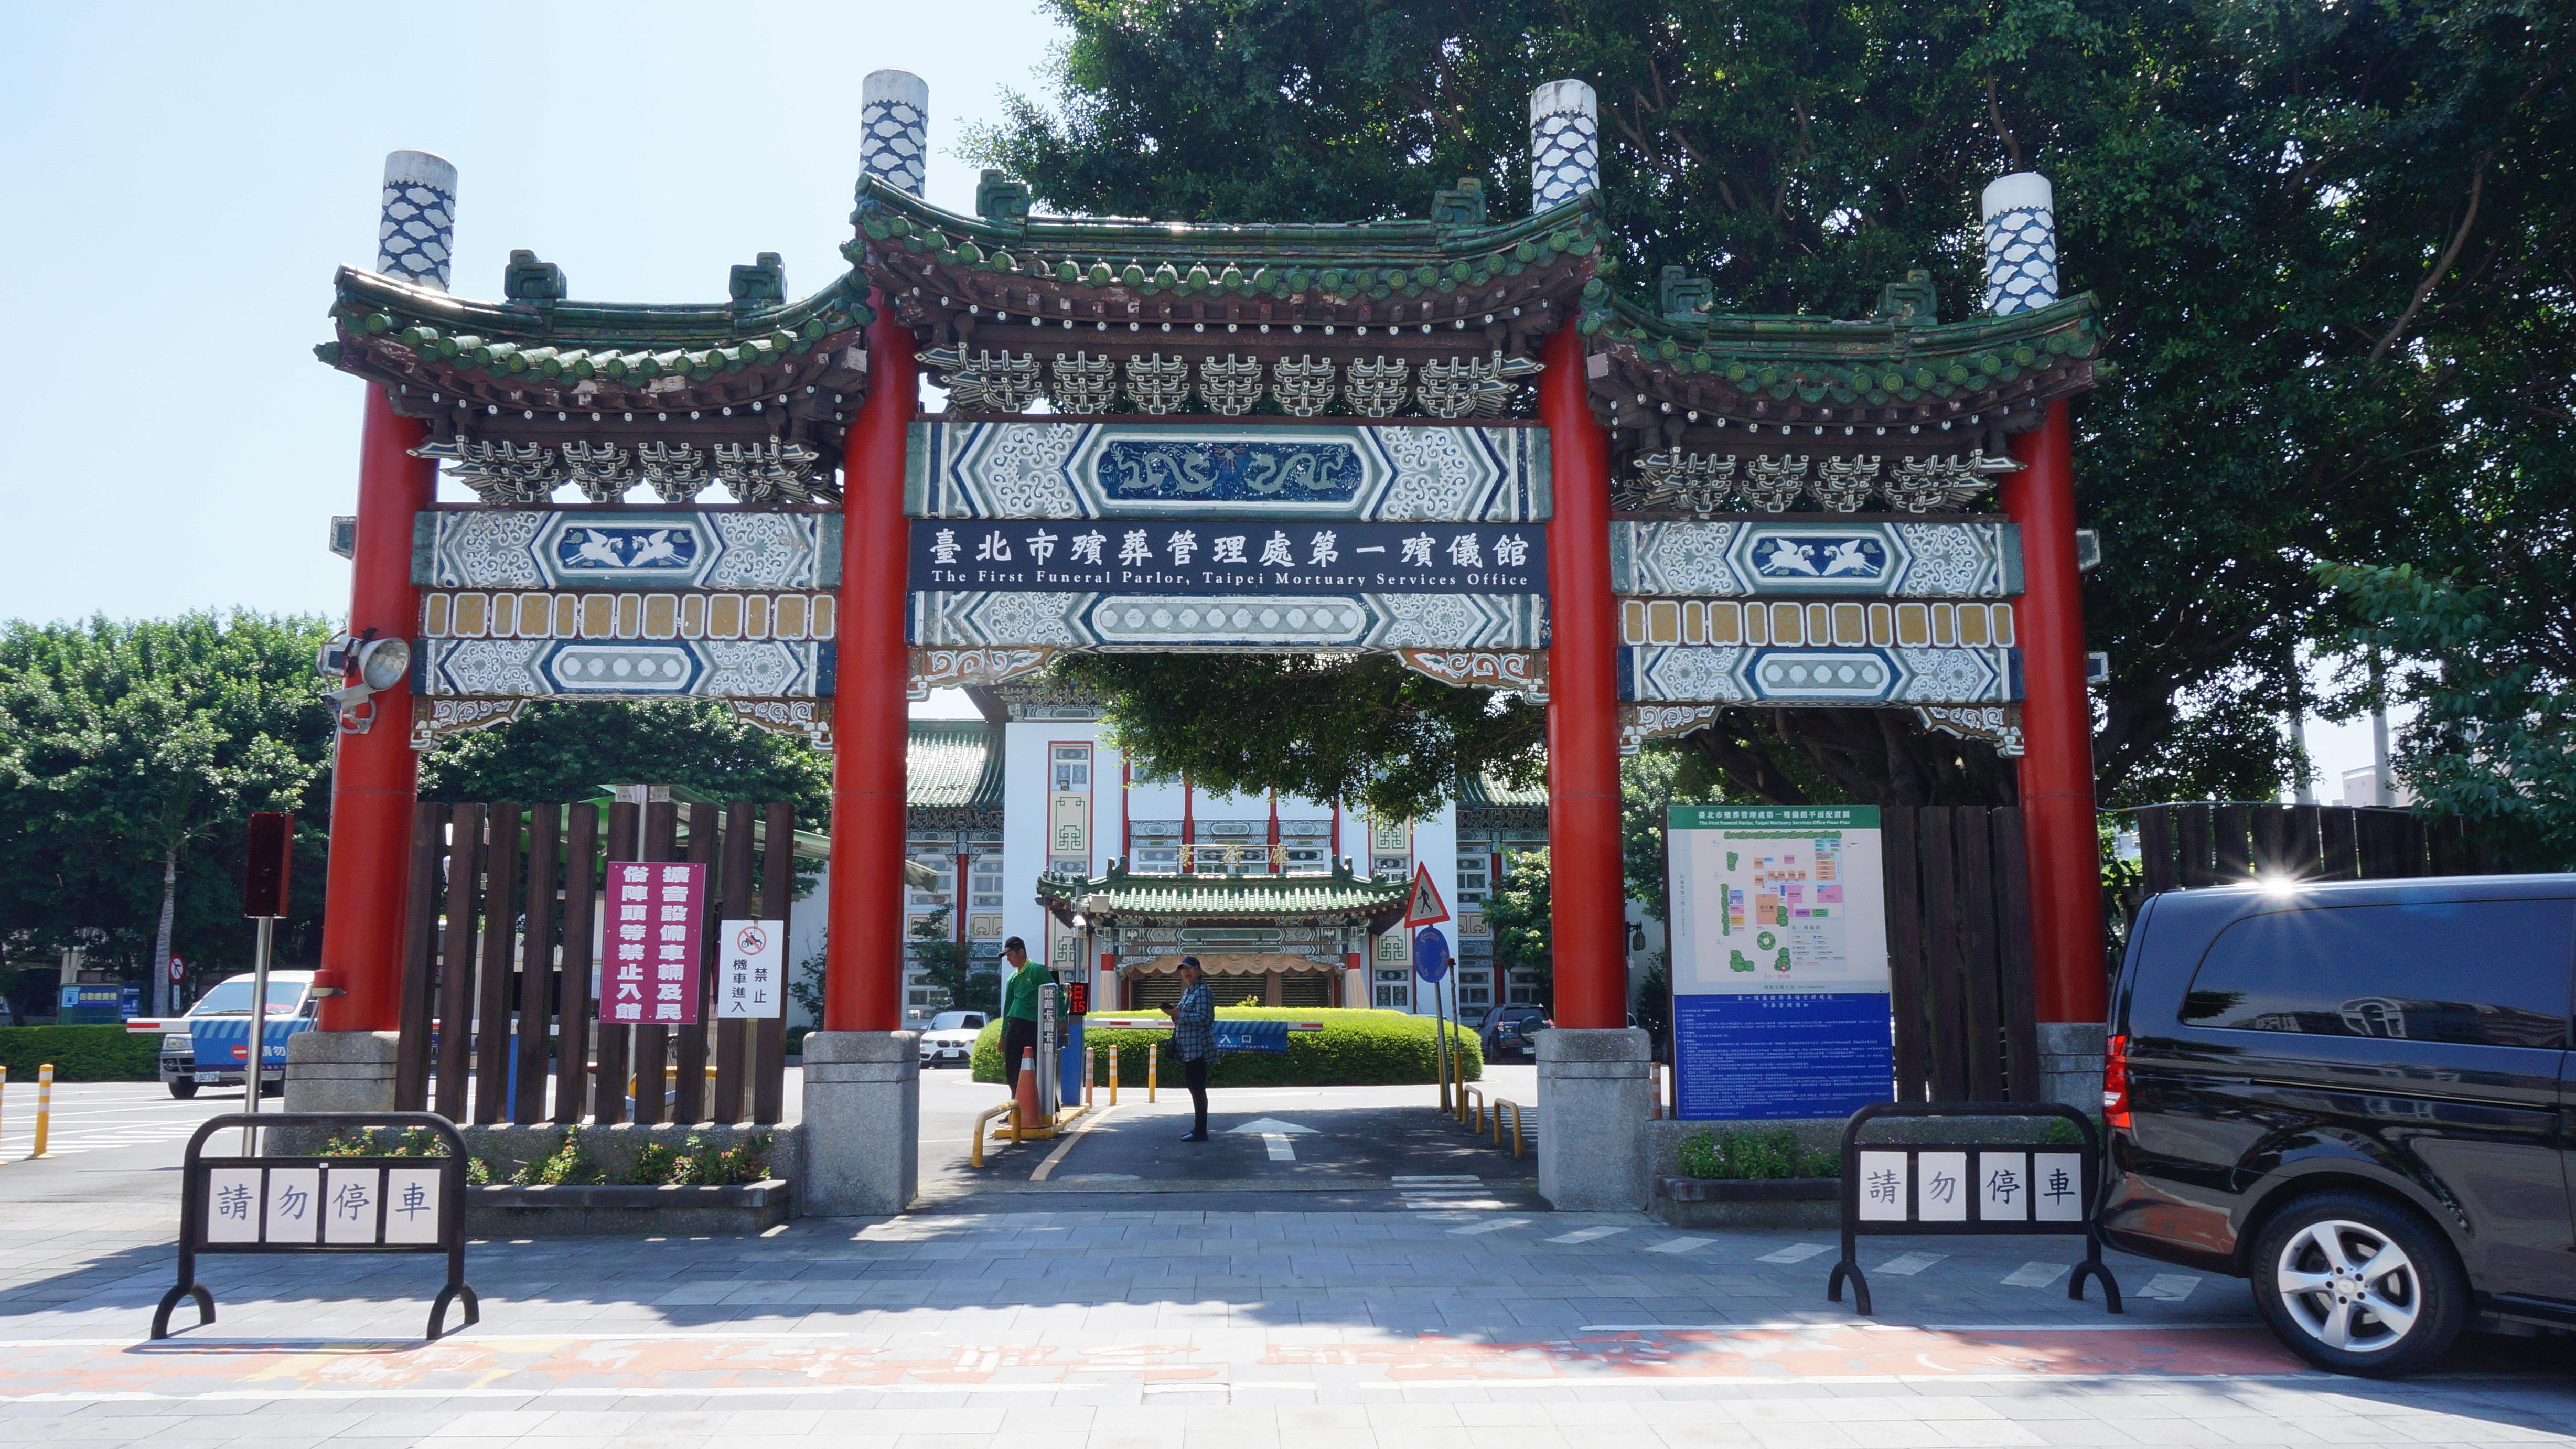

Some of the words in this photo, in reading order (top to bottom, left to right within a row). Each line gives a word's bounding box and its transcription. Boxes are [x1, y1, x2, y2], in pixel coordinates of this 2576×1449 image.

[929, 528, 1529, 568] 臺北市殯葬管理處第一殯儀館
[932, 570, 966, 582] The
[978, 570, 1024, 582] First
[1036, 570, 1110, 583] Funeral
[1122, 571, 1190, 586] Parlor,
[1202, 572, 1263, 586] Taipei
[1275, 572, 1366, 587] Mortuary
[1377, 573, 1456, 585] Services
[1467, 573, 1527, 586] Office
[615, 866, 649, 1020] 俗陣頭等禁止入館
[656, 866, 690, 1021] 擴音設備車輛及民
[731, 959, 748, 1013] 機車進入
[753, 967, 768, 1004] 禁止
[1073, 1001, 1085, 1012] 15
[1219, 1034, 1251, 1044] 入口
[216, 1182, 431, 1222] 請勿停車
[1867, 1167, 2075, 1206] 請勿停車
